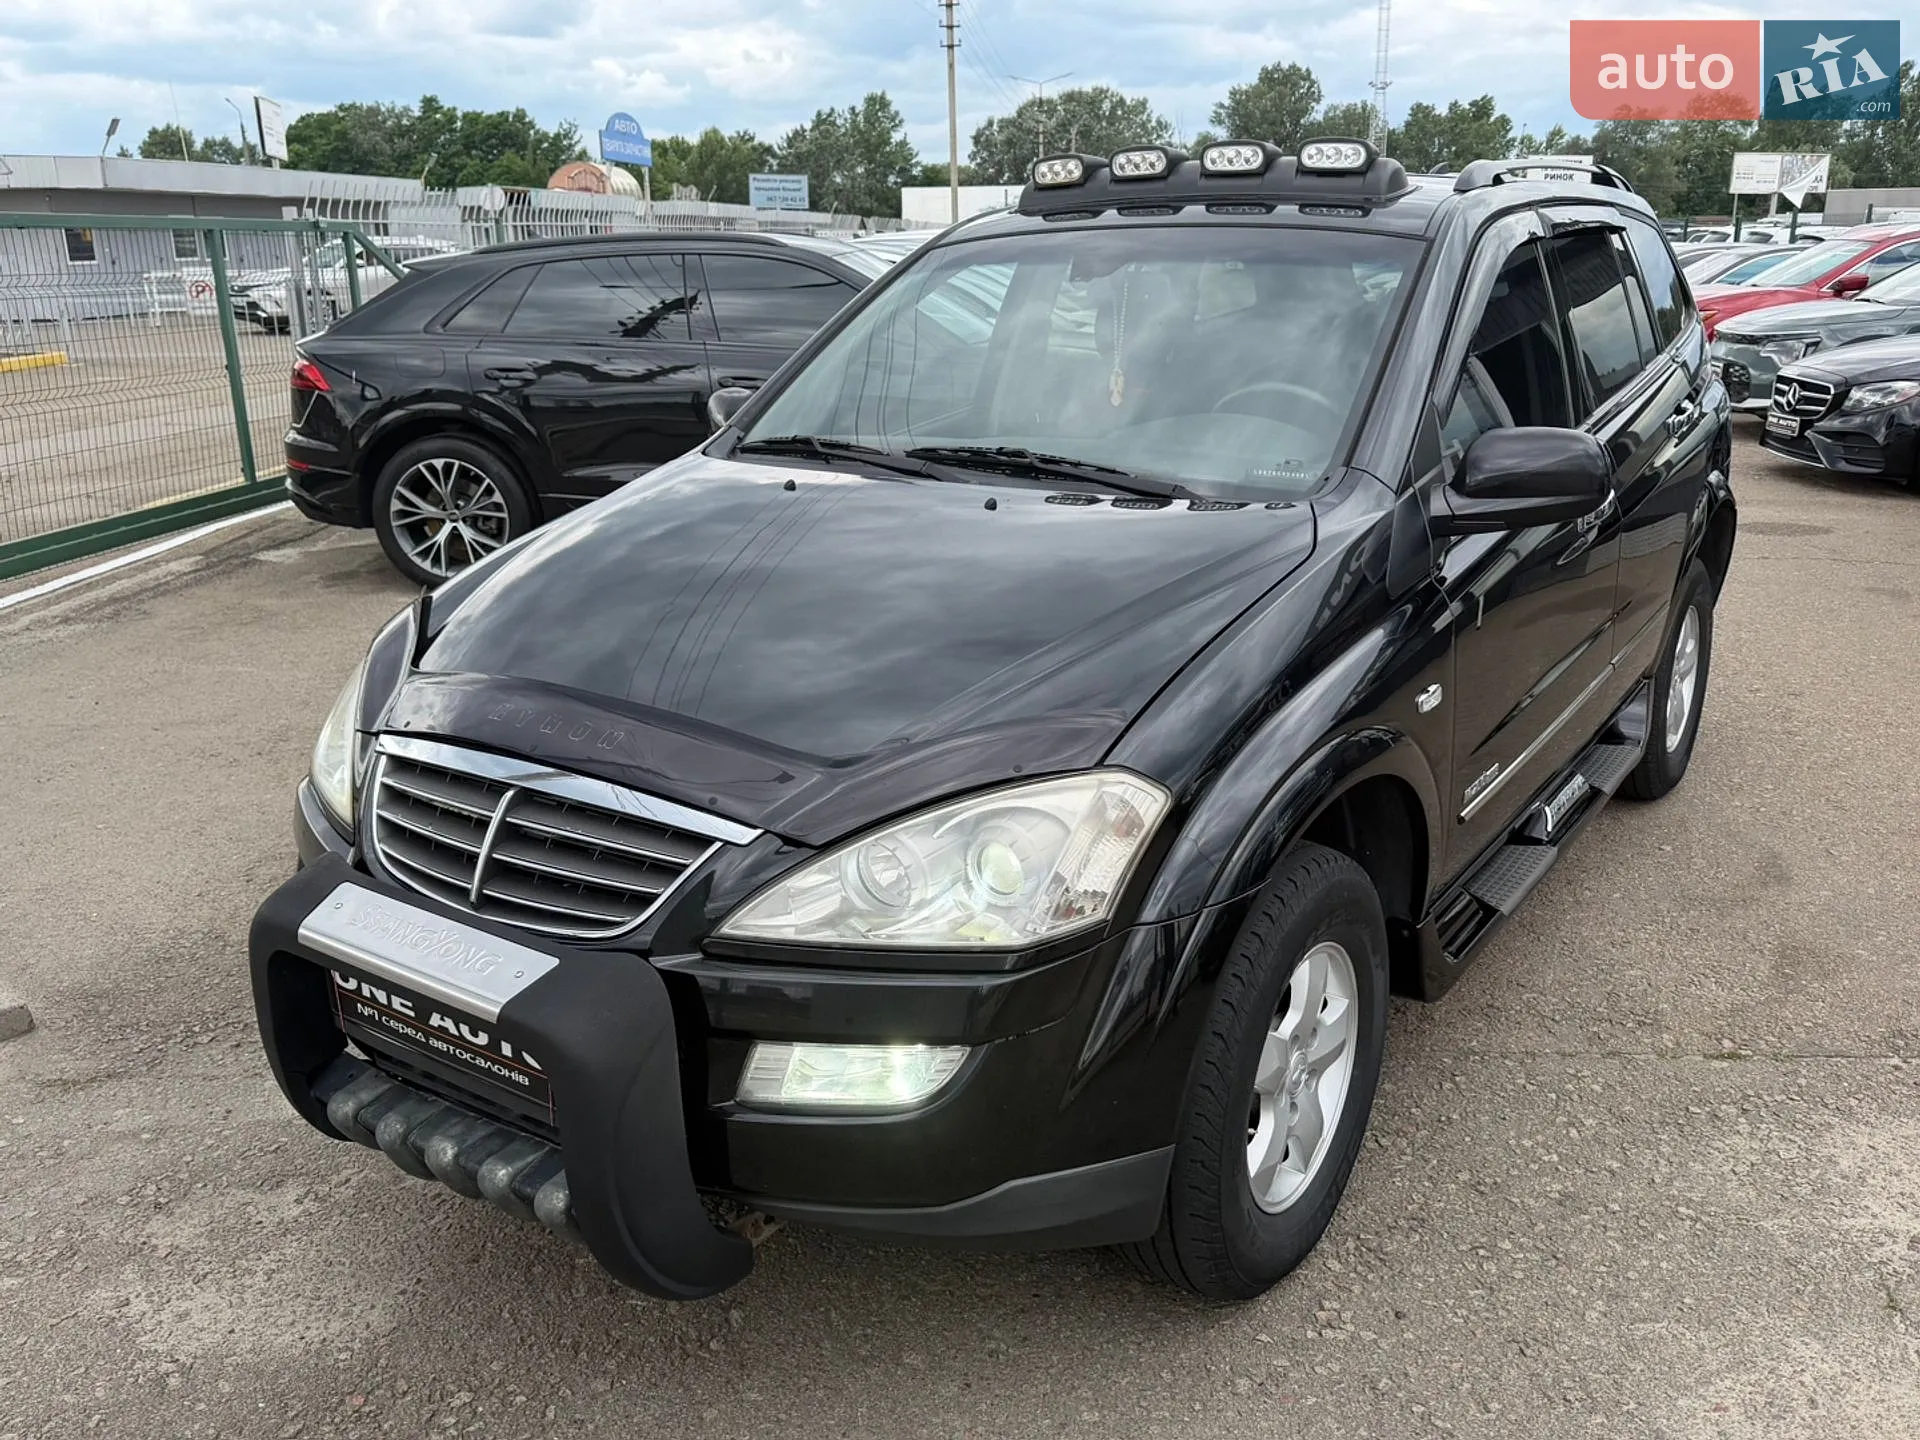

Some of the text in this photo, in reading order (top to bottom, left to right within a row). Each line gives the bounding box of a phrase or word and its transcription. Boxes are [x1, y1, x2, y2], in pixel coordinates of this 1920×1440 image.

[613, 119, 638, 135] АВТО
[1543, 173, 1575, 181] РИНОК
[382, 1015, 426, 1043] серед
[428, 1036, 530, 1087] автосалонів
